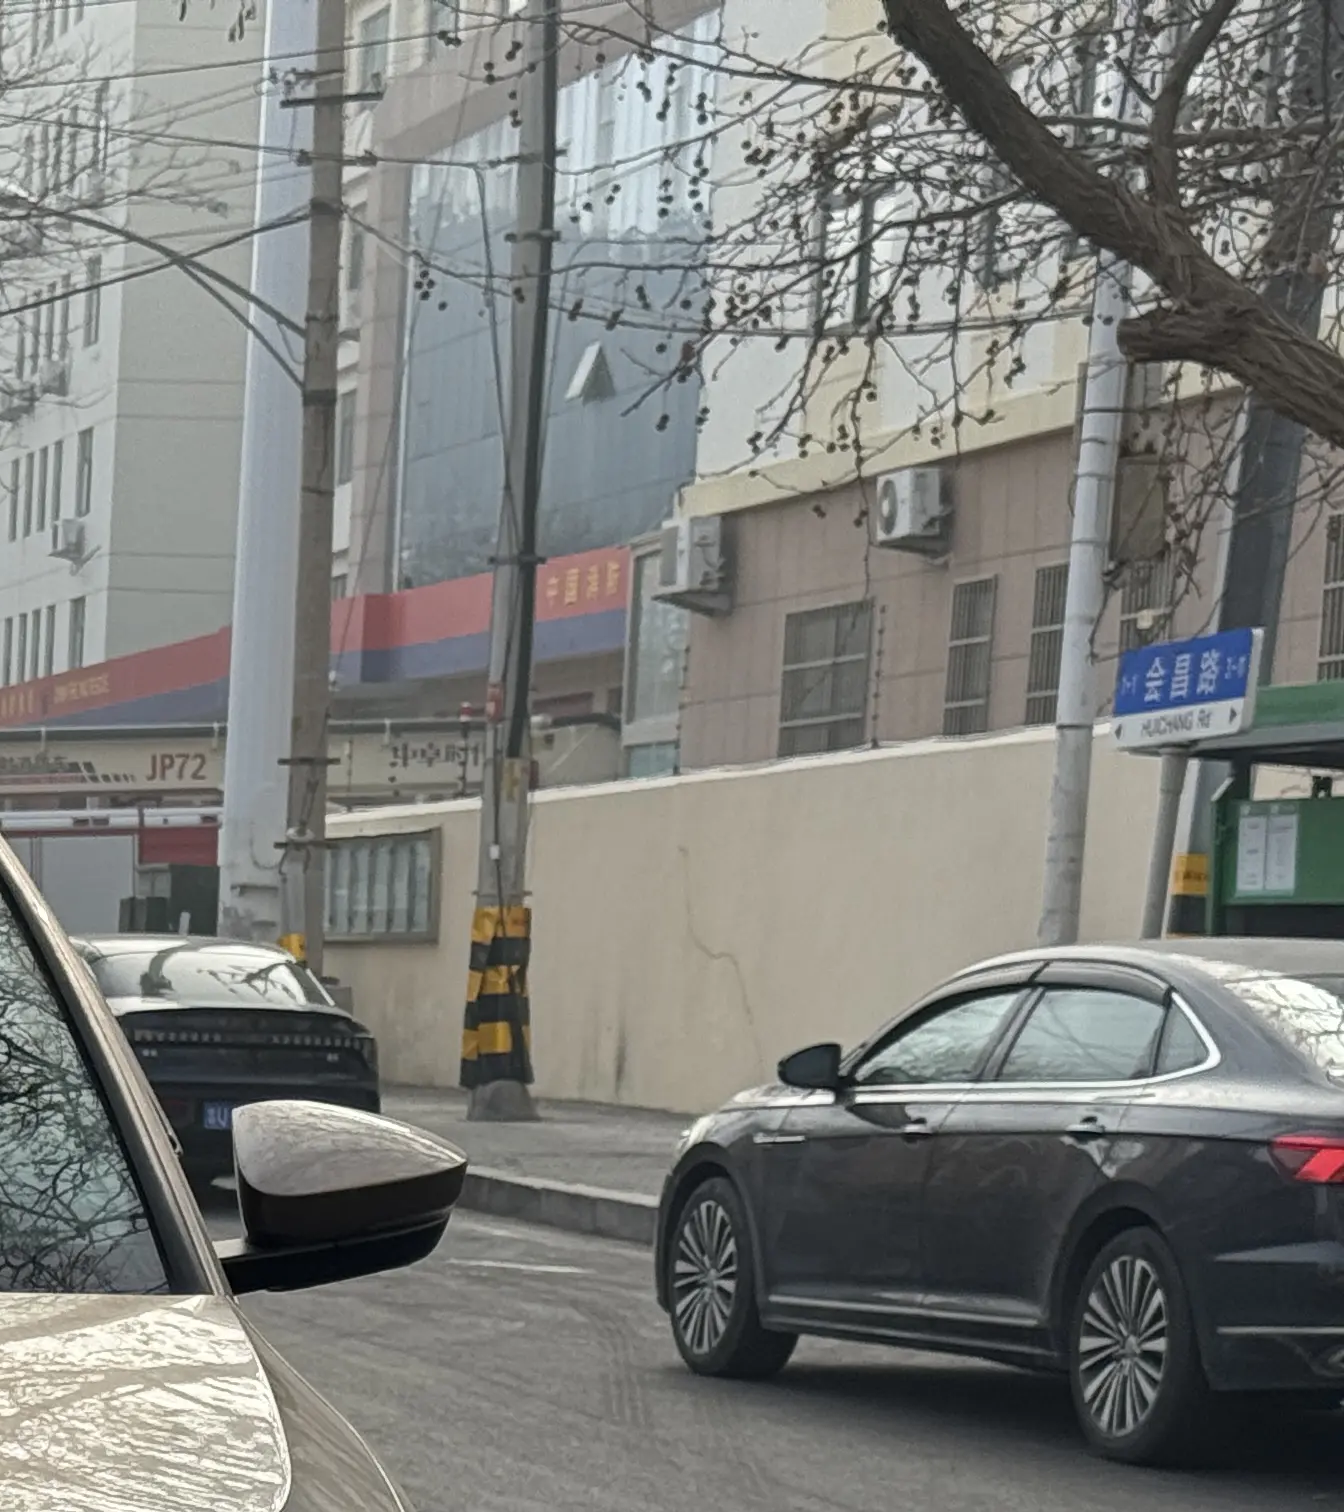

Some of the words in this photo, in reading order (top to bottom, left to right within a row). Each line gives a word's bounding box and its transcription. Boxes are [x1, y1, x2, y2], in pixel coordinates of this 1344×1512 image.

[1144, 649, 1220, 702] 会昌路
[146, 754, 206, 781] JP72
